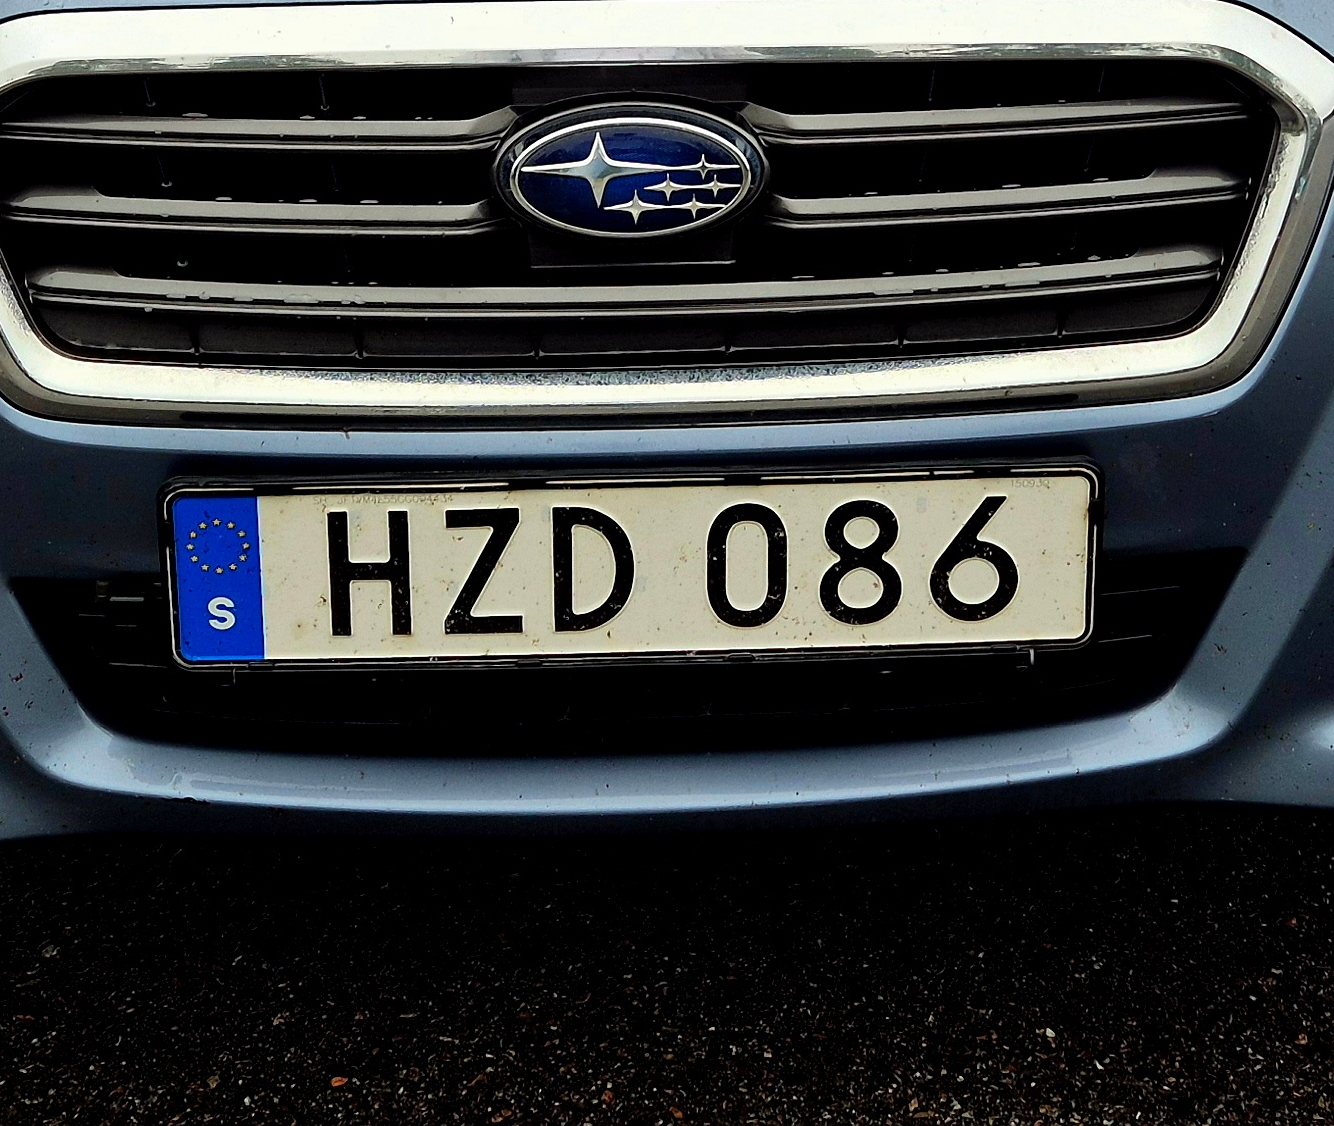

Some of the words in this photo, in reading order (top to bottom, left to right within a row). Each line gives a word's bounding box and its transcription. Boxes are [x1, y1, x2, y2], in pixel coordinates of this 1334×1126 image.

[326, 506, 637, 638] HZD
[704, 495, 1020, 629] 086
[208, 596, 236, 630] S
